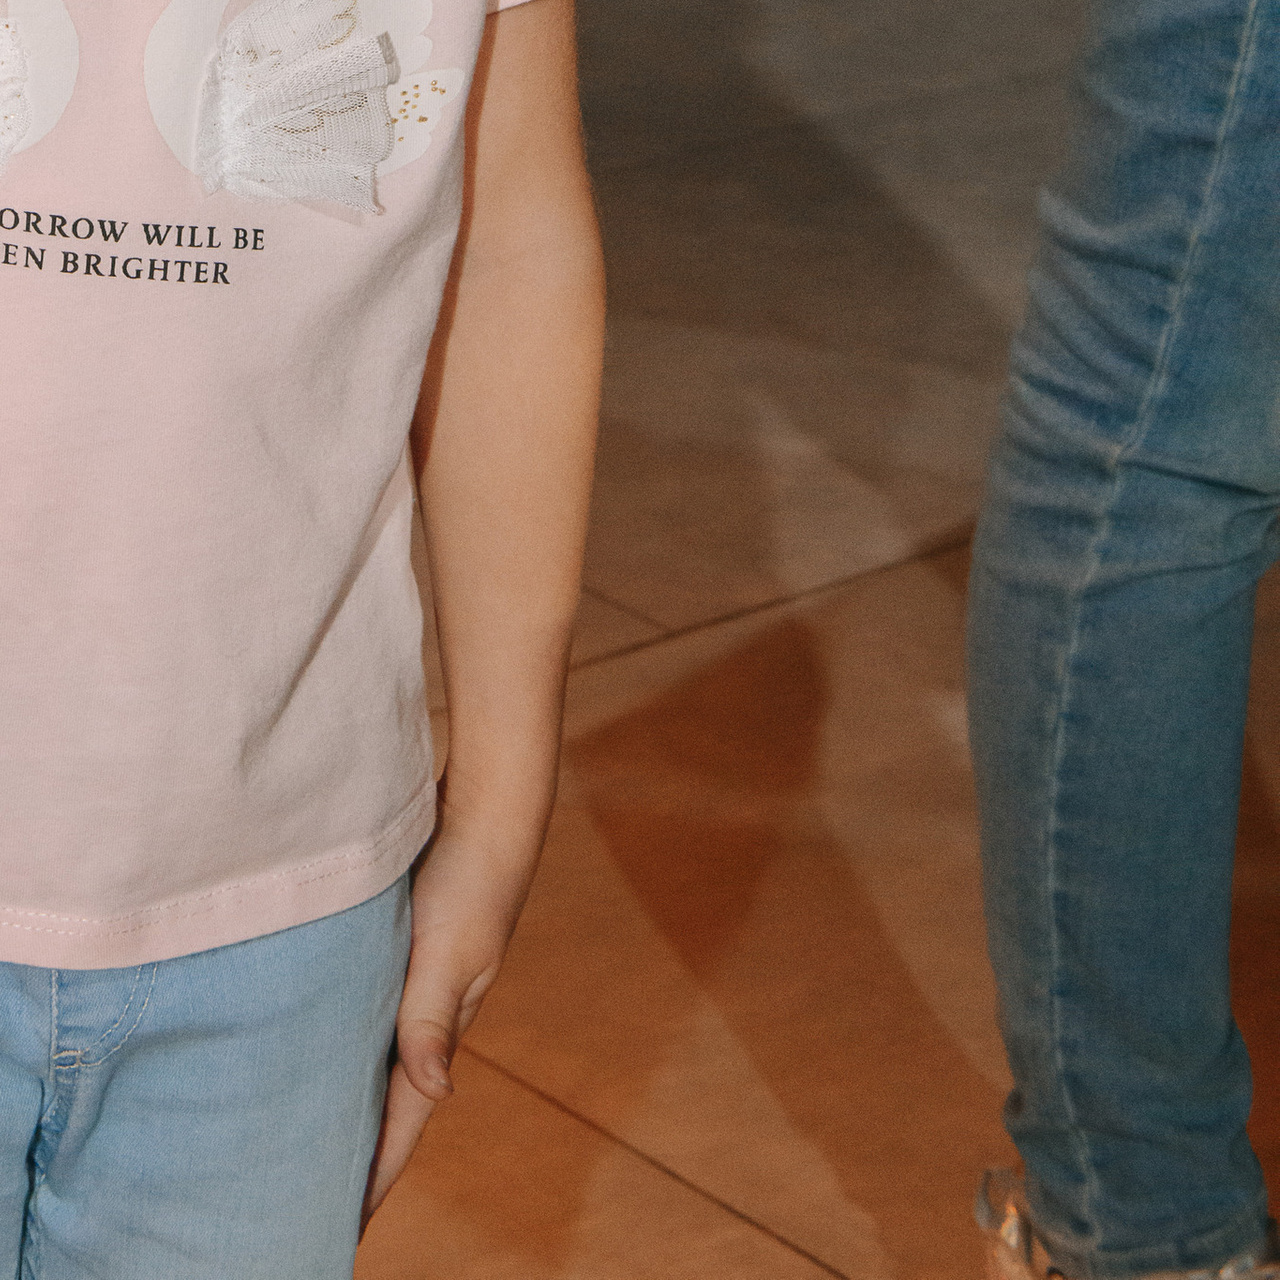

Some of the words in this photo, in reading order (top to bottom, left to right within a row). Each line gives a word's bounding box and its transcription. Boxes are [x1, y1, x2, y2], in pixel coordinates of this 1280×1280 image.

[142, 222, 222, 249] WILL
[232, 226, 266, 252] BE
[60, 250, 231, 286] BRIGHTER
